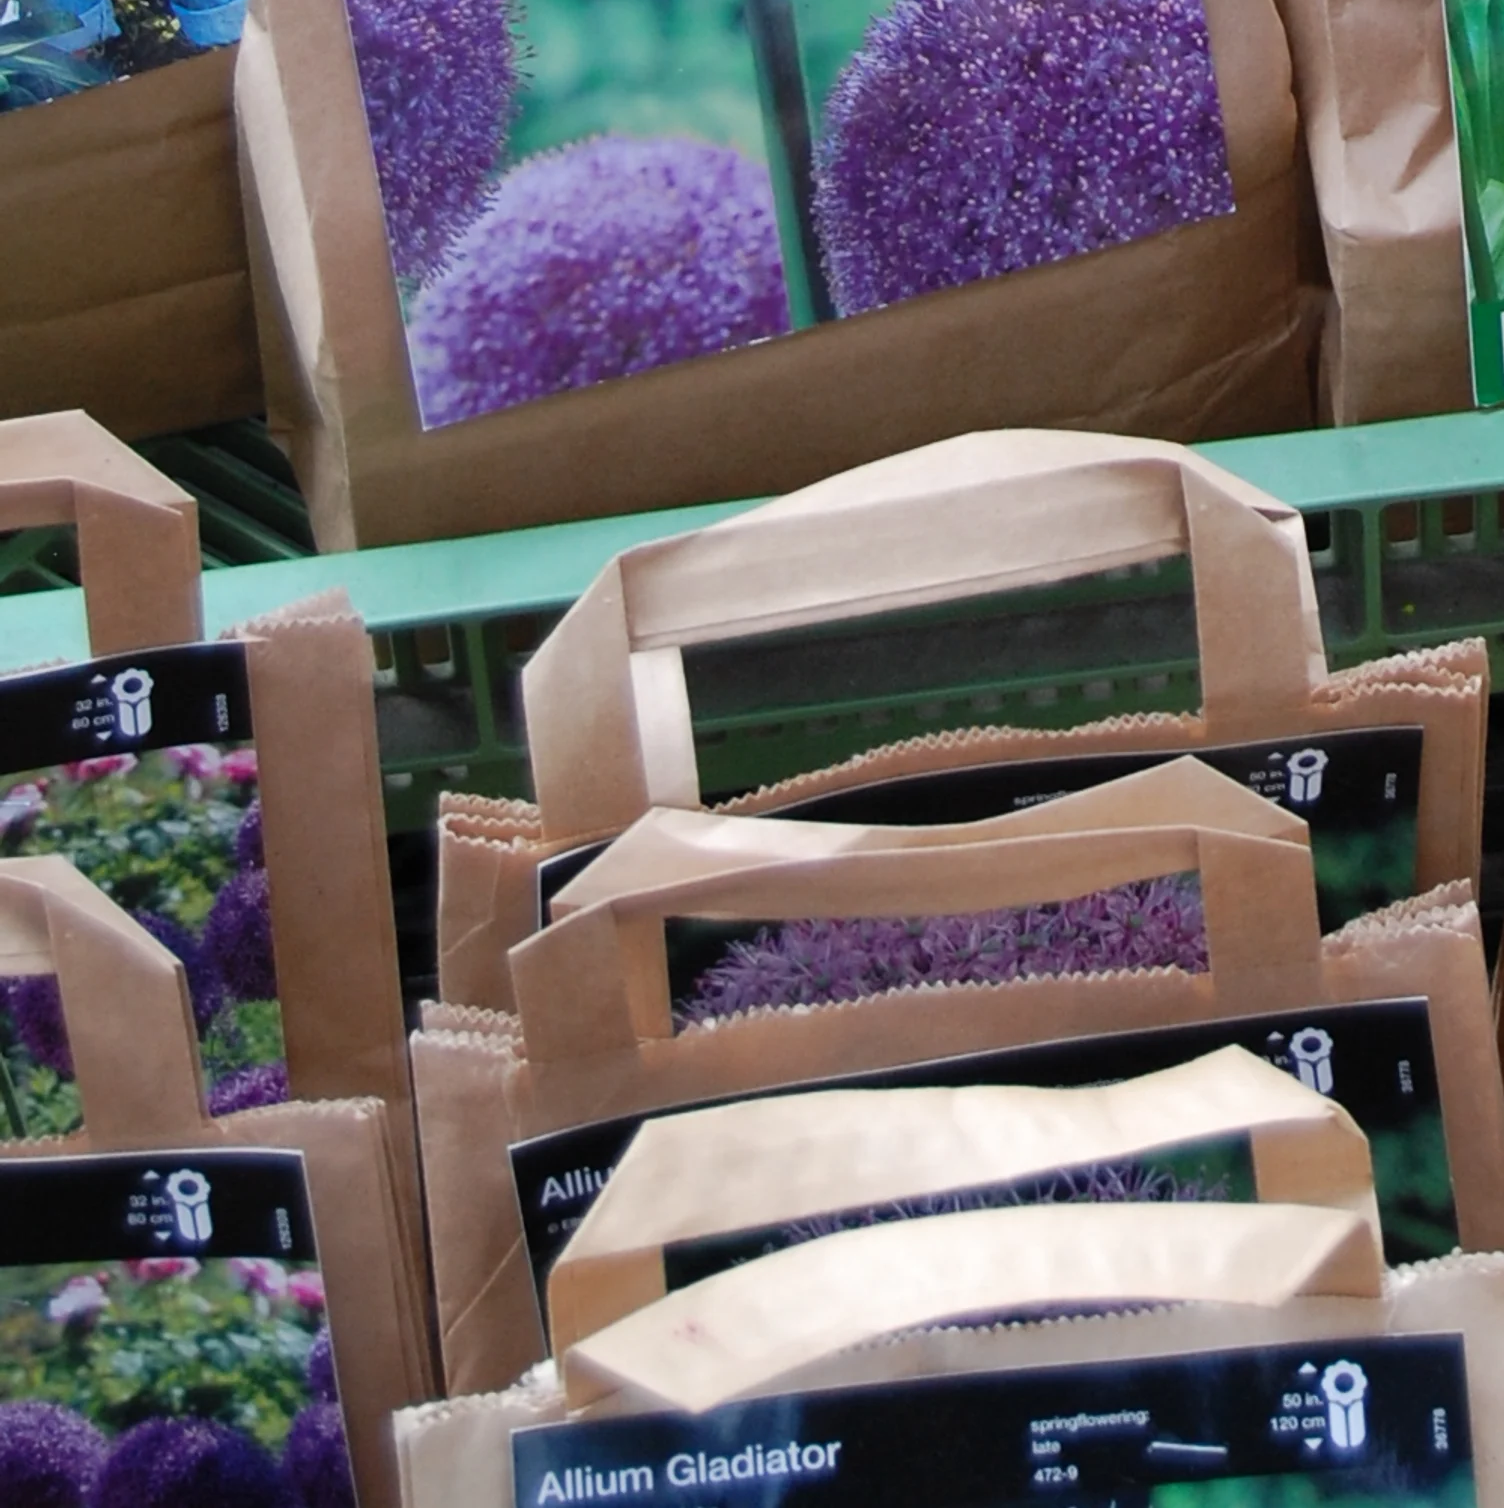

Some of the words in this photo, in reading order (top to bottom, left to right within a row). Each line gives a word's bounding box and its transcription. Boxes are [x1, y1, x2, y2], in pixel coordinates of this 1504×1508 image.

[93, 714, 116, 726] cm
[149, 1213, 173, 1224] cm
[1281, 1393, 1301, 1408] 50
[1304, 1392, 1324, 1406] in.
[1030, 1409, 1150, 1434] springflowering:
[1269, 1416, 1299, 1432] 120
[1302, 1416, 1326, 1430] cm
[1031, 1439, 1061, 1455] late
[537, 1465, 654, 1505] Allium
[666, 1440, 842, 1487] Gladiator
[1033, 1466, 1079, 1483] 472-9
